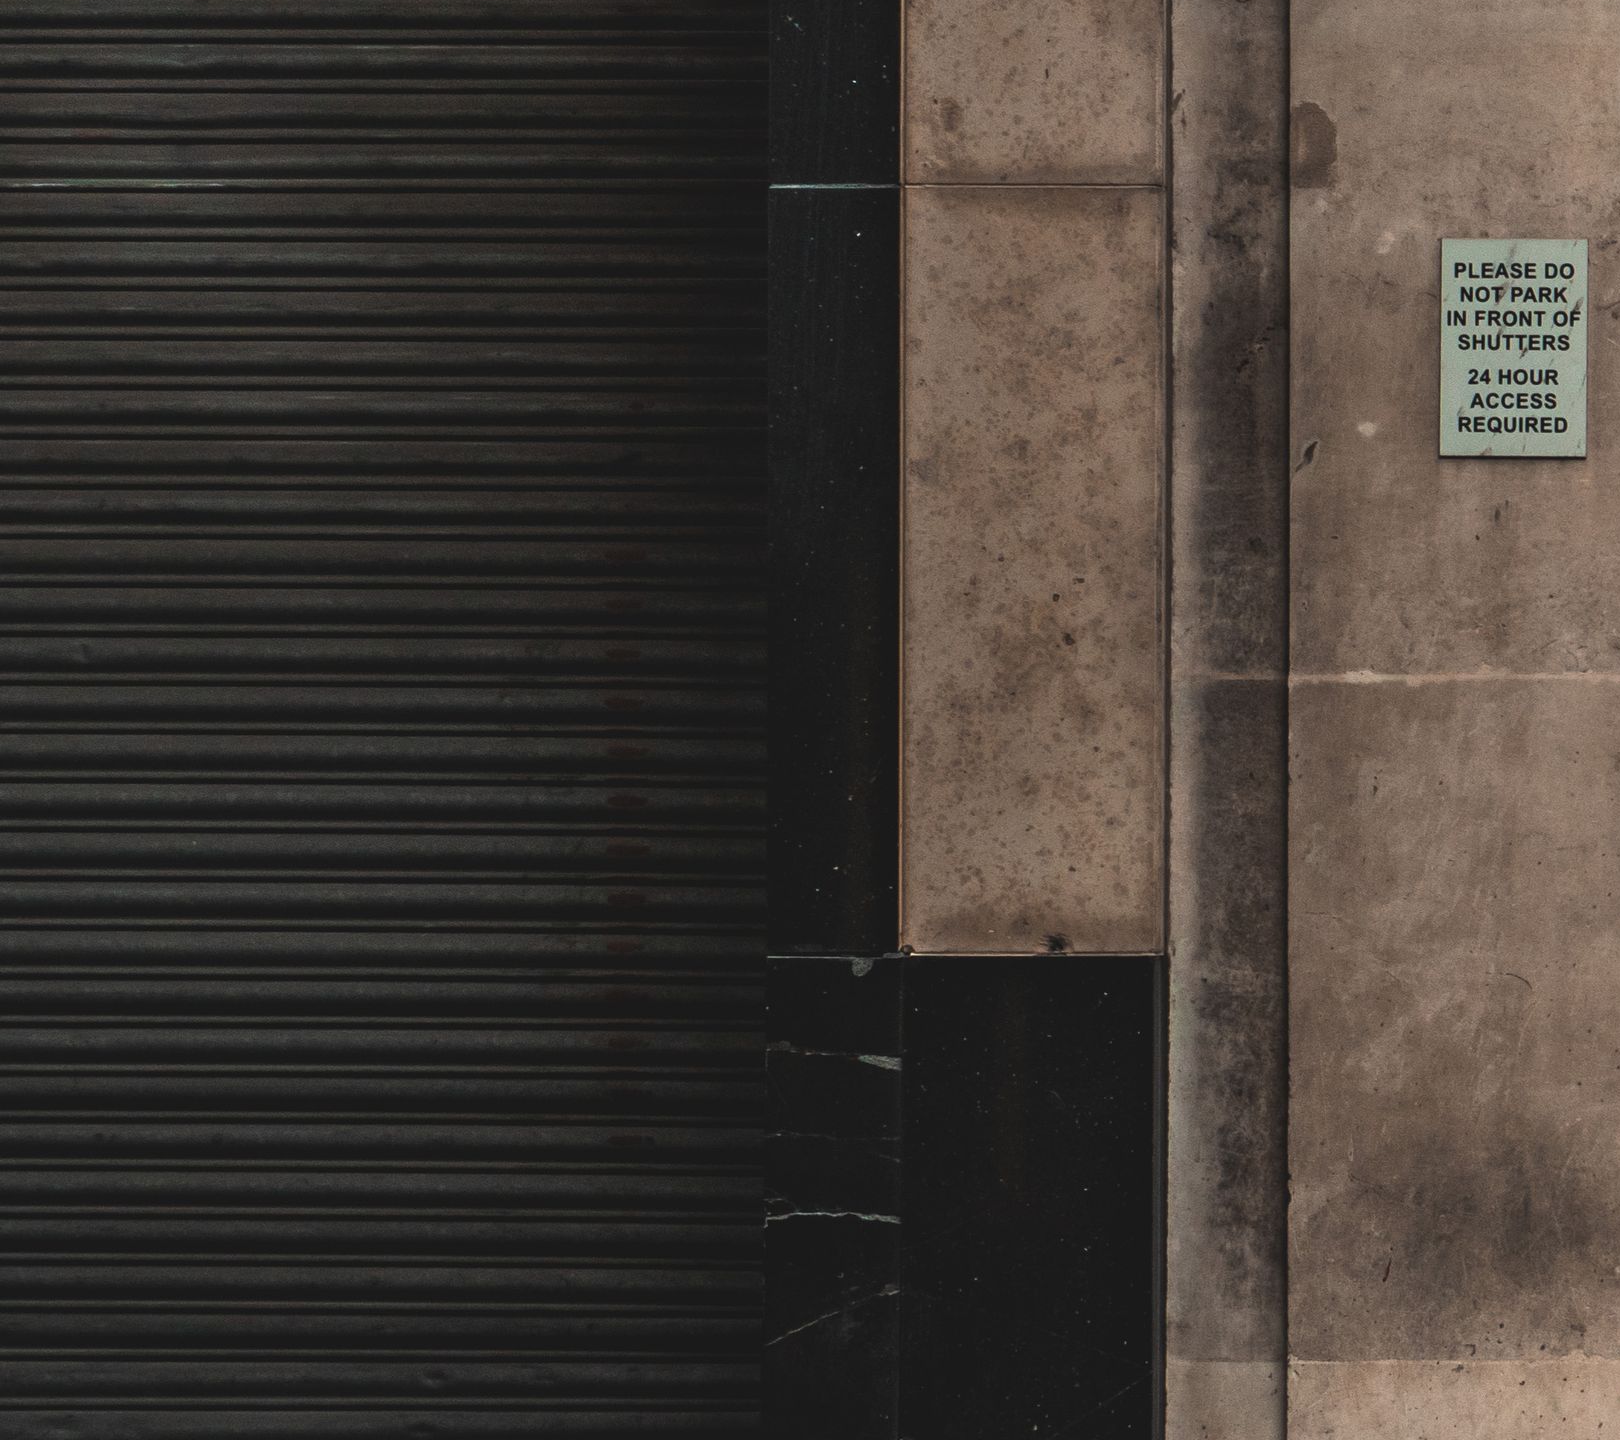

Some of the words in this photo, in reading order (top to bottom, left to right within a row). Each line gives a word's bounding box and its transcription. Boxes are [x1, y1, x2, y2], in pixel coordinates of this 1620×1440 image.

[1455, 263, 1536, 278] PLEASE
[1545, 263, 1574, 279] DO
[1461, 287, 1504, 302] NOT
[1511, 287, 1567, 303] PARK
[1448, 311, 1466, 326] IN
[1475, 311, 1546, 326] FRONT
[1553, 311, 1581, 327] OF
[1459, 335, 1569, 351] SHUTTERS
[1468, 369, 1491, 384] 24
[1499, 369, 1558, 385] HOUR
[1471, 393, 1556, 409] ACCESS
[1459, 417, 1567, 433] REQUIRED
